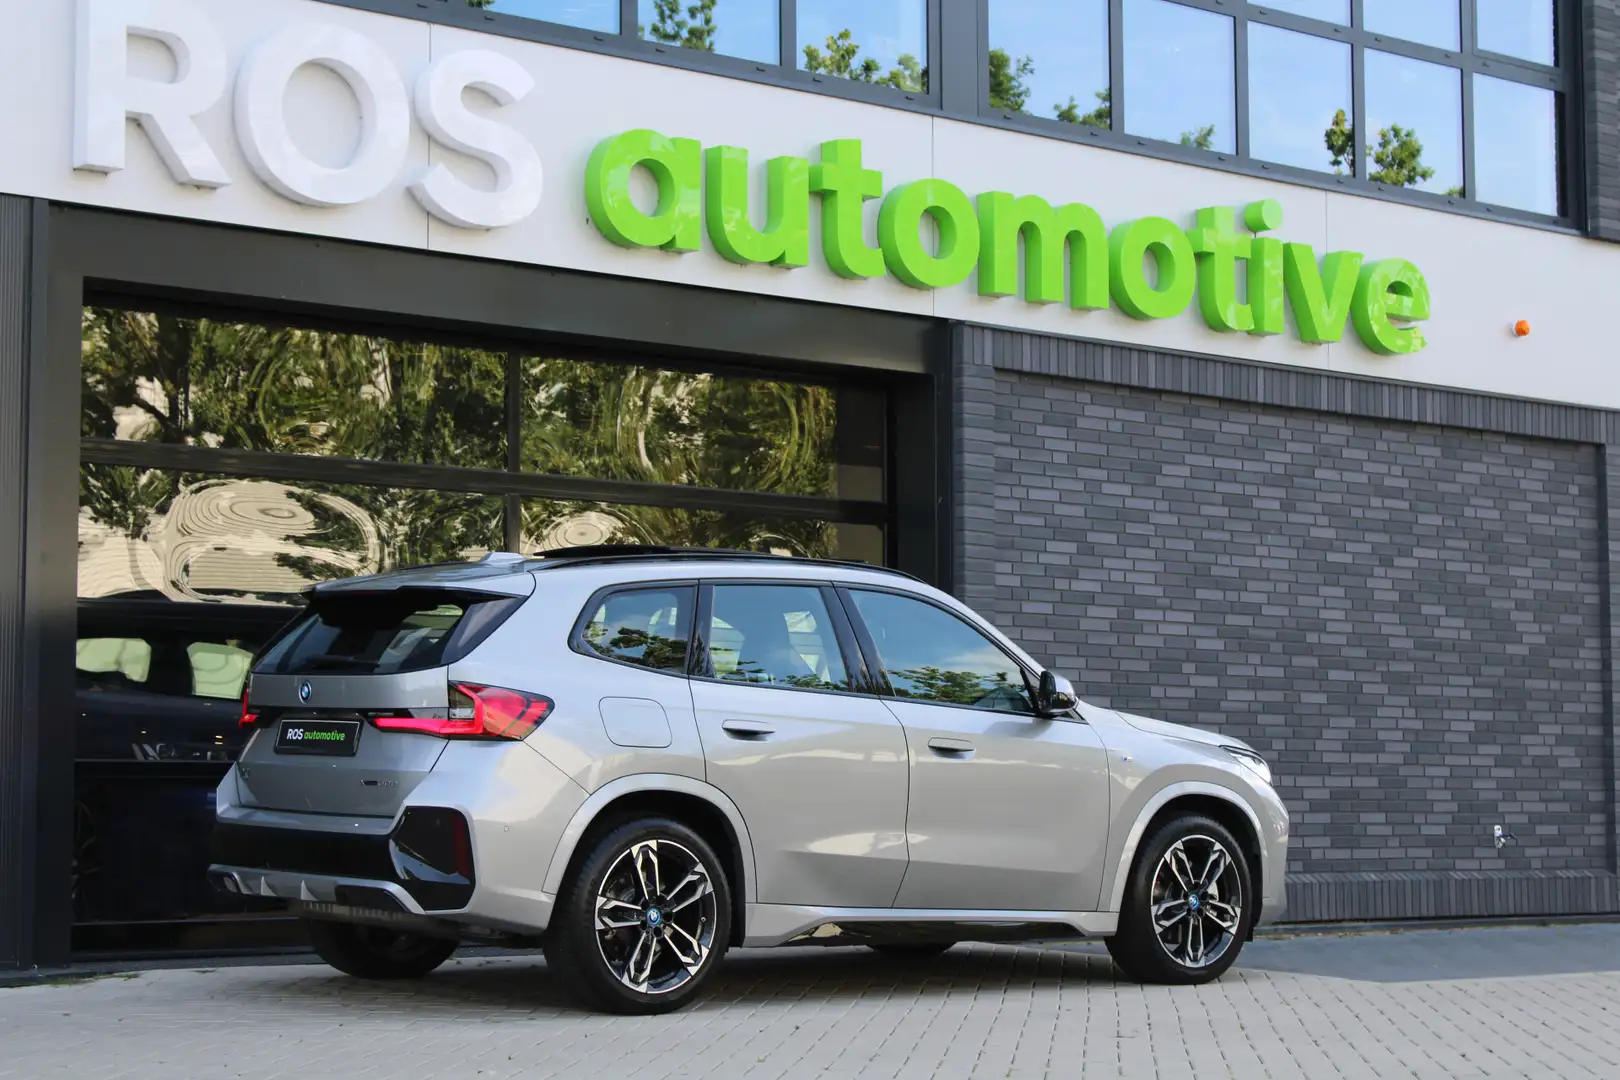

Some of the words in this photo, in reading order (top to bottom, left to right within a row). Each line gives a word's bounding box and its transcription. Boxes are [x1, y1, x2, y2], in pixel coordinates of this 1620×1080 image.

[73, 0, 543, 228] ROS
[585, 128, 1431, 355] automotive
[286, 728, 304, 740] ROS
[303, 730, 346, 741] automotive
